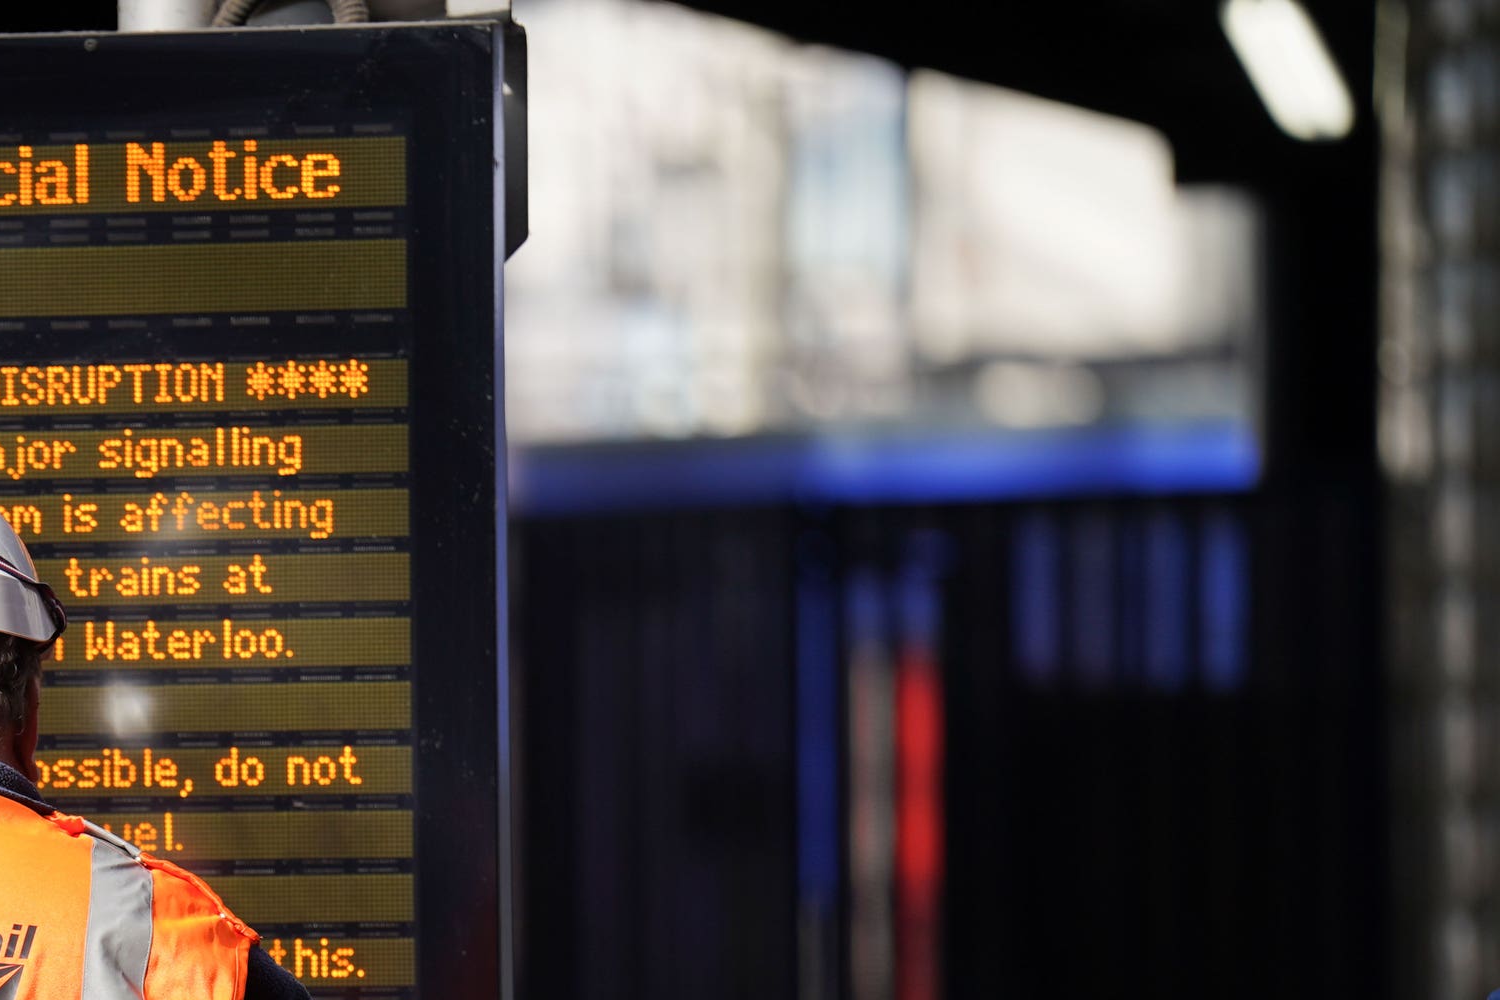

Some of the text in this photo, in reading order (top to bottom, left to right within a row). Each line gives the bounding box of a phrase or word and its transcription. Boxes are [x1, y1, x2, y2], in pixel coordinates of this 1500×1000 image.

[126, 139, 341, 203] Notice
[97, 426, 303, 479] signalling
[61, 492, 99, 534] is
[119, 489, 335, 540] affecting
[64, 553, 274, 598] trains at
[84, 618, 295, 661] Waterloo.
[35, 745, 364, 799] ossible, do not
